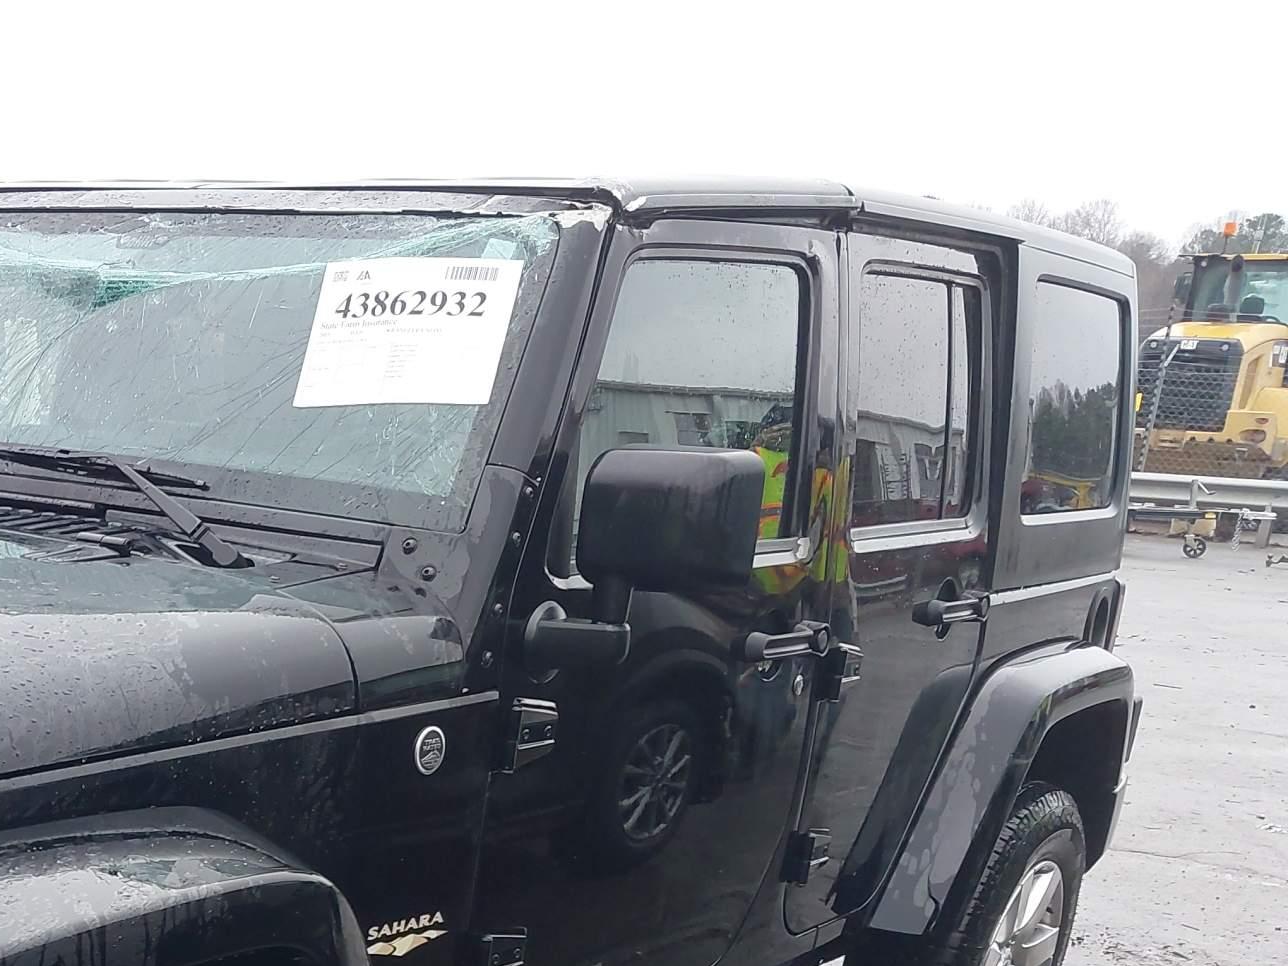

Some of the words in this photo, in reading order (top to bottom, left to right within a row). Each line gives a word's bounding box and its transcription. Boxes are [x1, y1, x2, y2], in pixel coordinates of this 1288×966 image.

[334, 289, 488, 319] 43862932
[362, 317, 399, 328] Insurance
[367, 911, 444, 941] SAHARA
